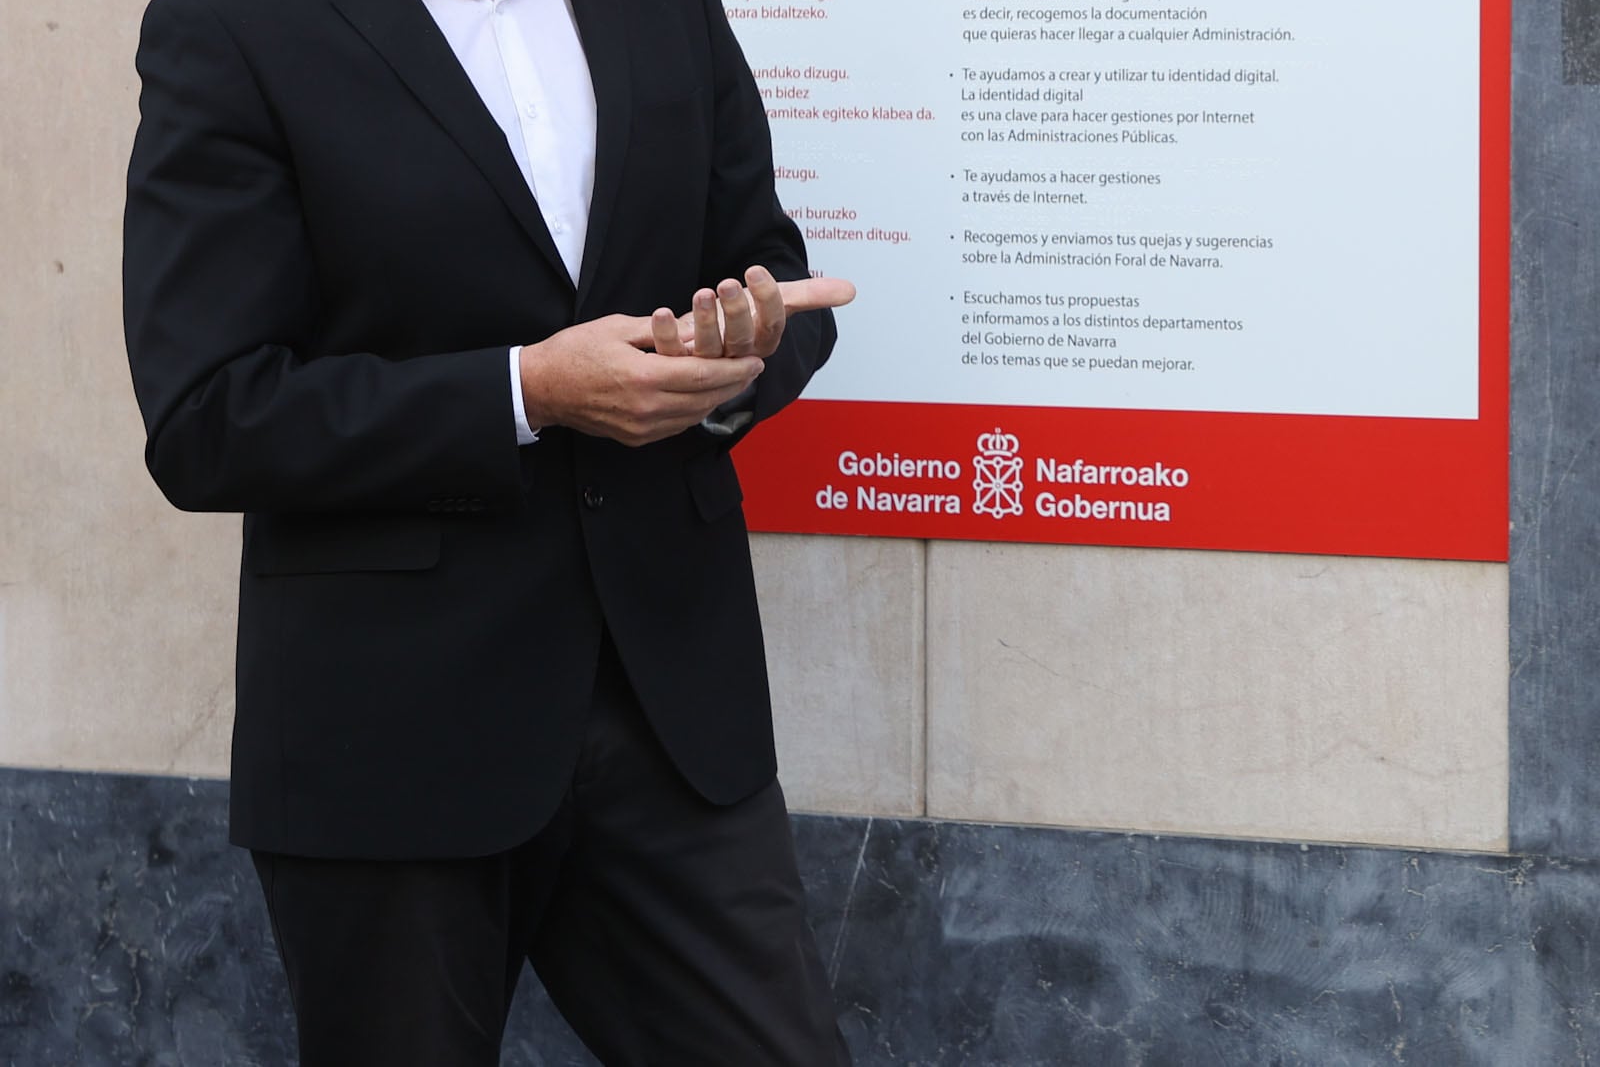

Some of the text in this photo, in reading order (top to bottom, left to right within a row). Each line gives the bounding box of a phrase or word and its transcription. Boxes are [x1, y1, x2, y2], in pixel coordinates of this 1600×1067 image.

[762, 6, 827, 18] bidaltzeko.
[980, 7, 1207, 23] decir, recogemos documentación
[963, 27, 1294, 43] que quieras hacer llegar cualquier Administración.
[804, 67, 848, 82] dizugu.
[962, 68, 1278, 85] Te ayudamos crear utilizar tu identidad digital.
[776, 87, 808, 98] bidez
[962, 88, 1083, 104] La identidad digital
[823, 108, 935, 121] egiteko klabea da.
[978, 109, 1254, 125] una clave para hacer gestiones por Internet
[961, 129, 1177, 143] con las Administraciones Públicas.
[963, 169, 1160, 187] Te ayudamos hacer gestiones
[973, 190, 1087, 204] través de Internet.
[807, 207, 856, 219] buruzko
[806, 226, 910, 244] bidaltzen ditugu.
[964, 230, 1273, 250] Recogemos enviamos tus quejas sugerencias
[962, 250, 1222, 267] sobre Administración Foral de Navarra.
[964, 291, 1139, 309] Escuchamos tus propuestas
[973, 311, 1243, 331] informamos los distintos departamentos
[962, 331, 1116, 348] del Gobierno de Navarra
[962, 351, 1194, 372] de los temas que puedan mejorar.
[839, 451, 960, 479] Gobierno
[1037, 458, 1189, 487] Nafarroako
[816, 485, 960, 514] de Navarra
[1036, 492, 1170, 521] Gobernua
